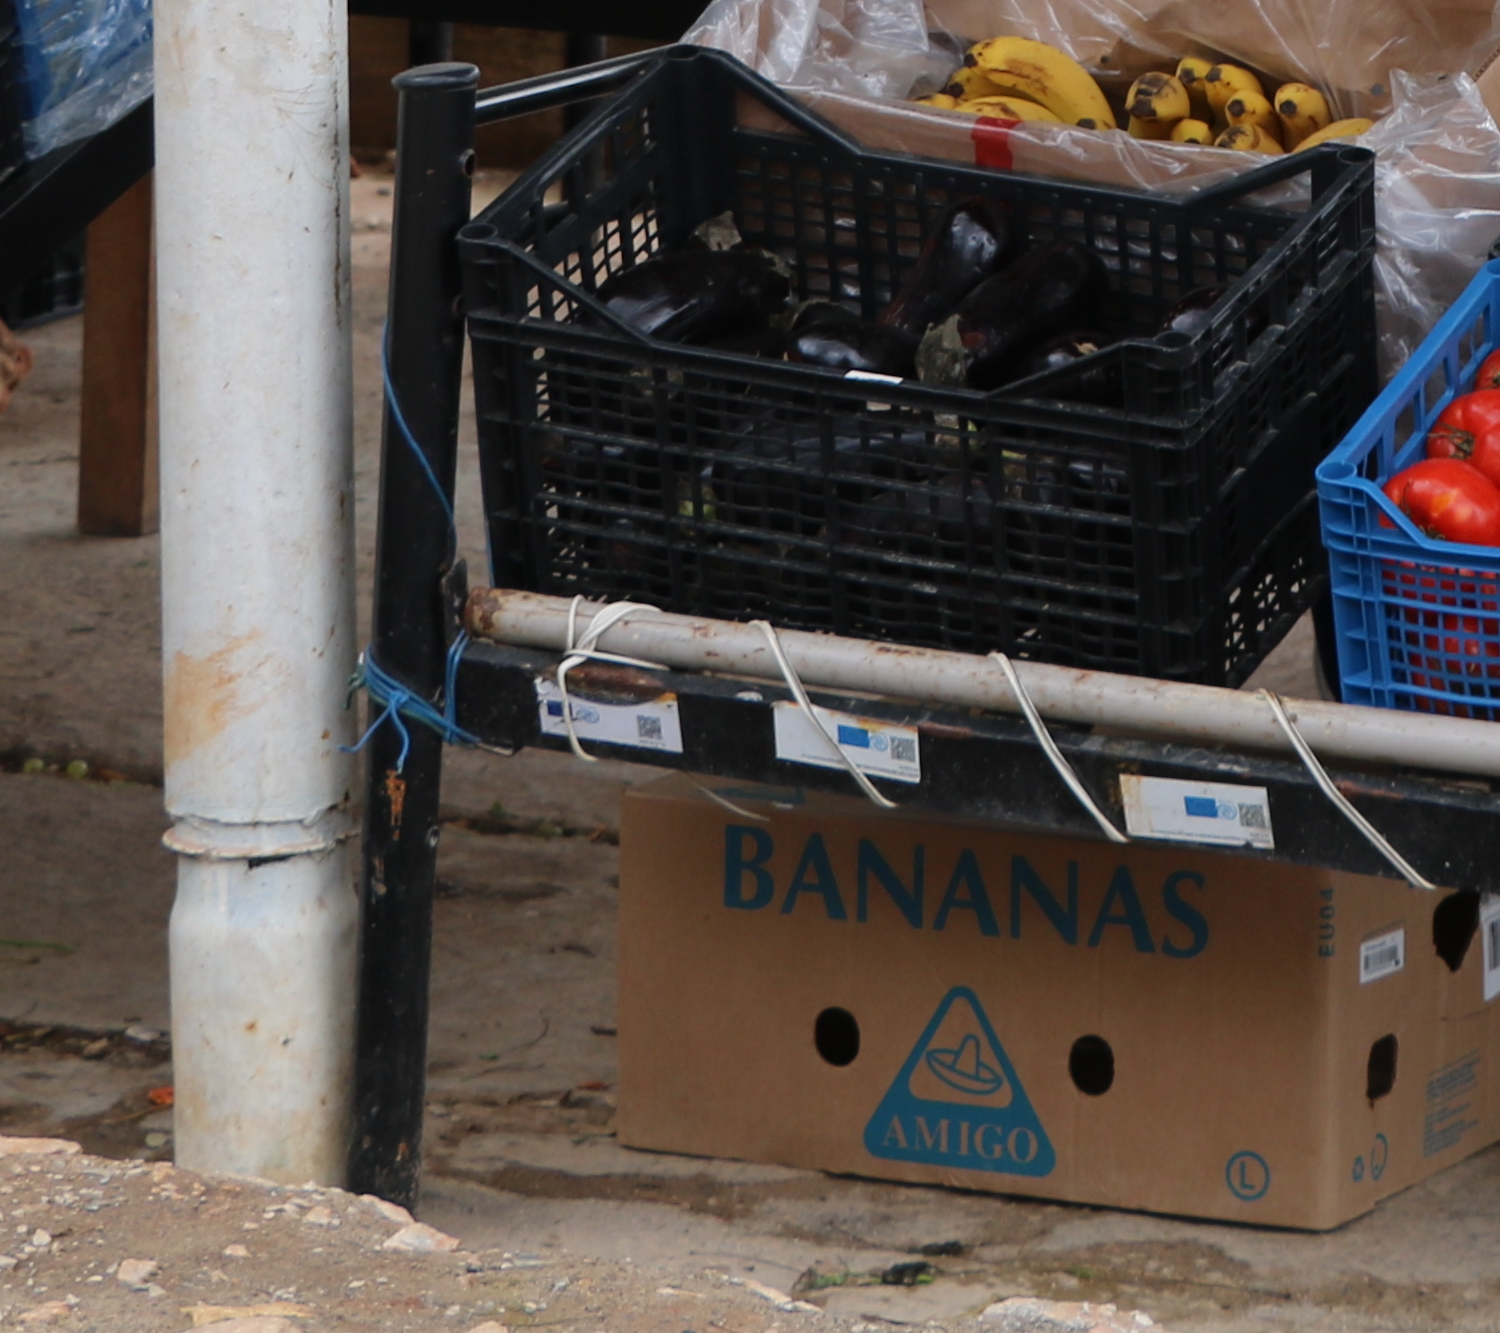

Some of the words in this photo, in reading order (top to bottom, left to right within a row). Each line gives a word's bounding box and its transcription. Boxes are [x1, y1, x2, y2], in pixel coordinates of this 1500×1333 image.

[724, 823, 1210, 959] BANANAS
[1318, 887, 1336, 958] EU04
[882, 1114, 1039, 1165] AMIGO
